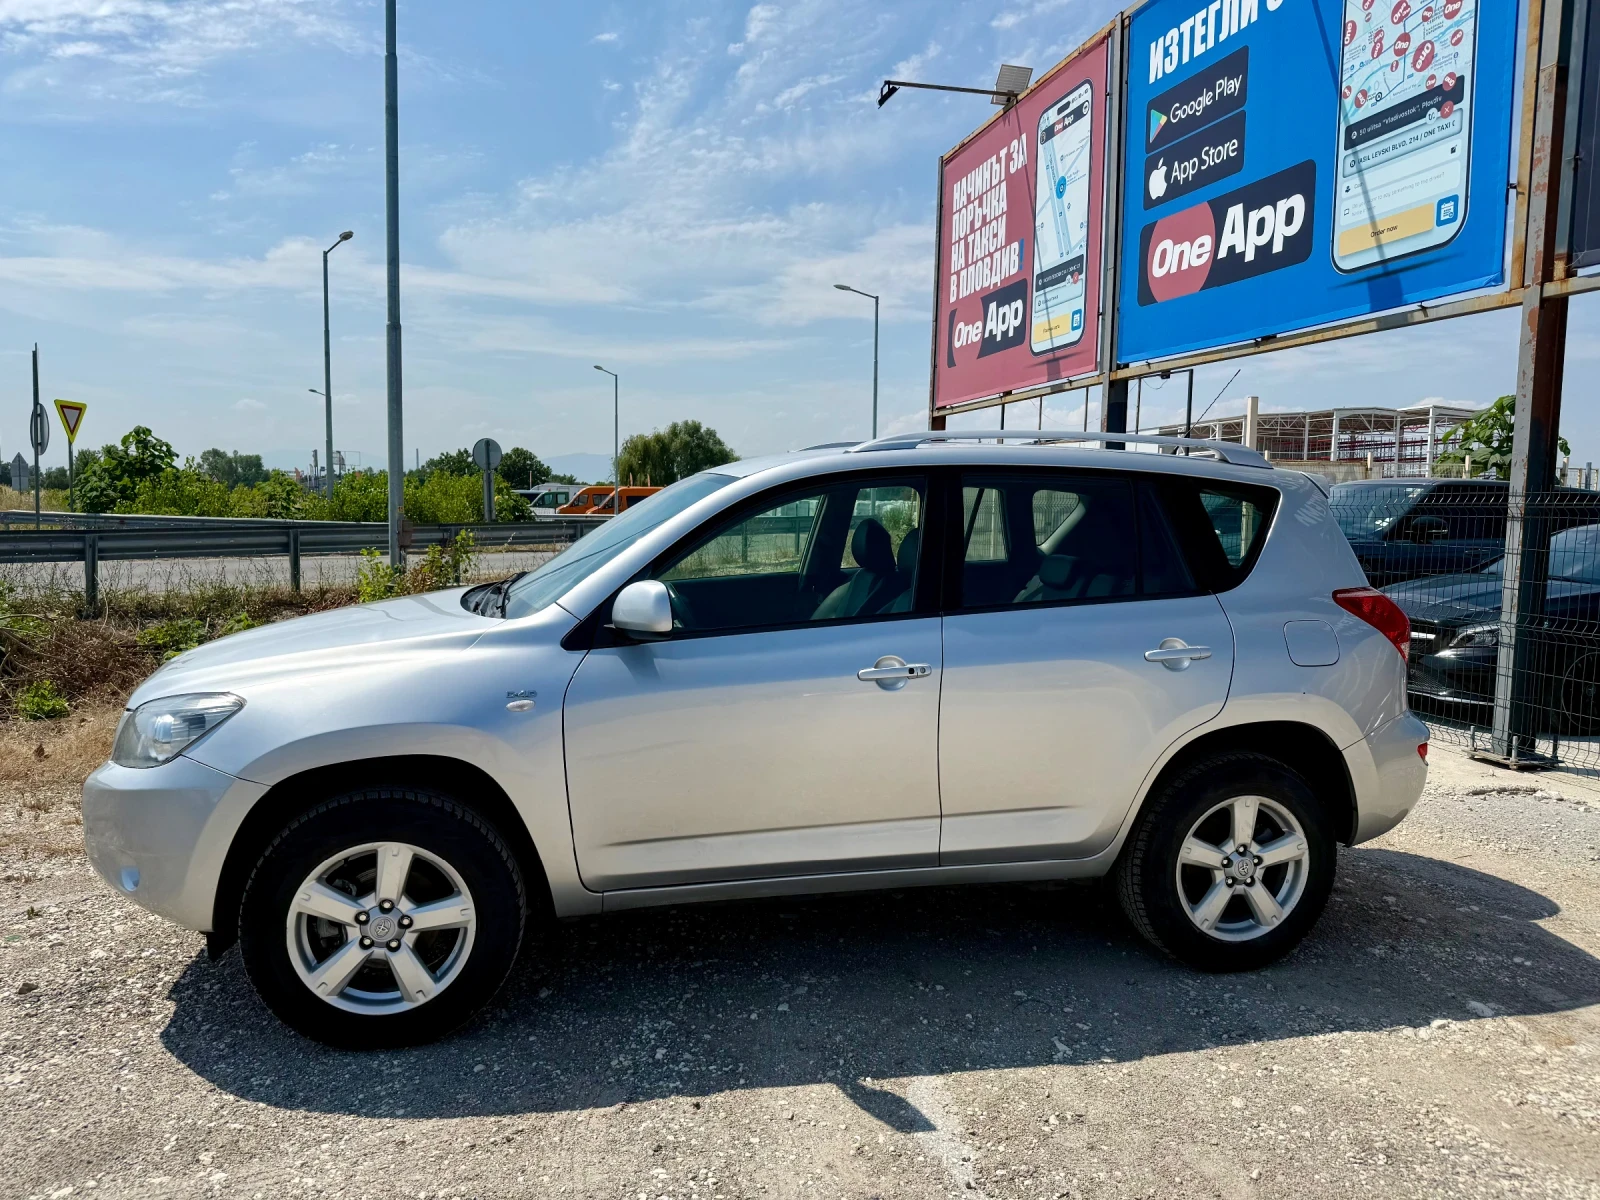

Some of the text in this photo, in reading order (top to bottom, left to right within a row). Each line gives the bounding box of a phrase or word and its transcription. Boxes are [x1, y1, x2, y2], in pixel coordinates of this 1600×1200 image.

[1393, 2, 1406, 22] One
[1444, 1, 1461, 14] One
[1149, 0, 1258, 84] ИЗТЕГЛИ
[1416, 42, 1432, 69] One
[1170, 74, 1242, 123] Google Play
[1422, 96, 1442, 108] Plovdiv
[1170, 139, 1238, 185] App Store
[1372, 146, 1390, 159] LEVSKI
[1392, 139, 1408, 150] BLVD.
[1409, 135, 1419, 144] 214
[1424, 128, 1436, 138] ONE
[1437, 122, 1451, 132] TAXI
[953, 146, 1007, 213] НАЧИНЪТ
[1010, 133, 1027, 174] ЗА
[952, 180, 1007, 243] ПОРЪЧКА
[1152, 194, 1306, 278] One App
[1370, 227, 1385, 238] Order
[951, 214, 1006, 274] НА ТАКСИ
[950, 274, 957, 304] В
[959, 238, 1024, 300] ПЛОВДИВ!
[954, 299, 1023, 348] One App
